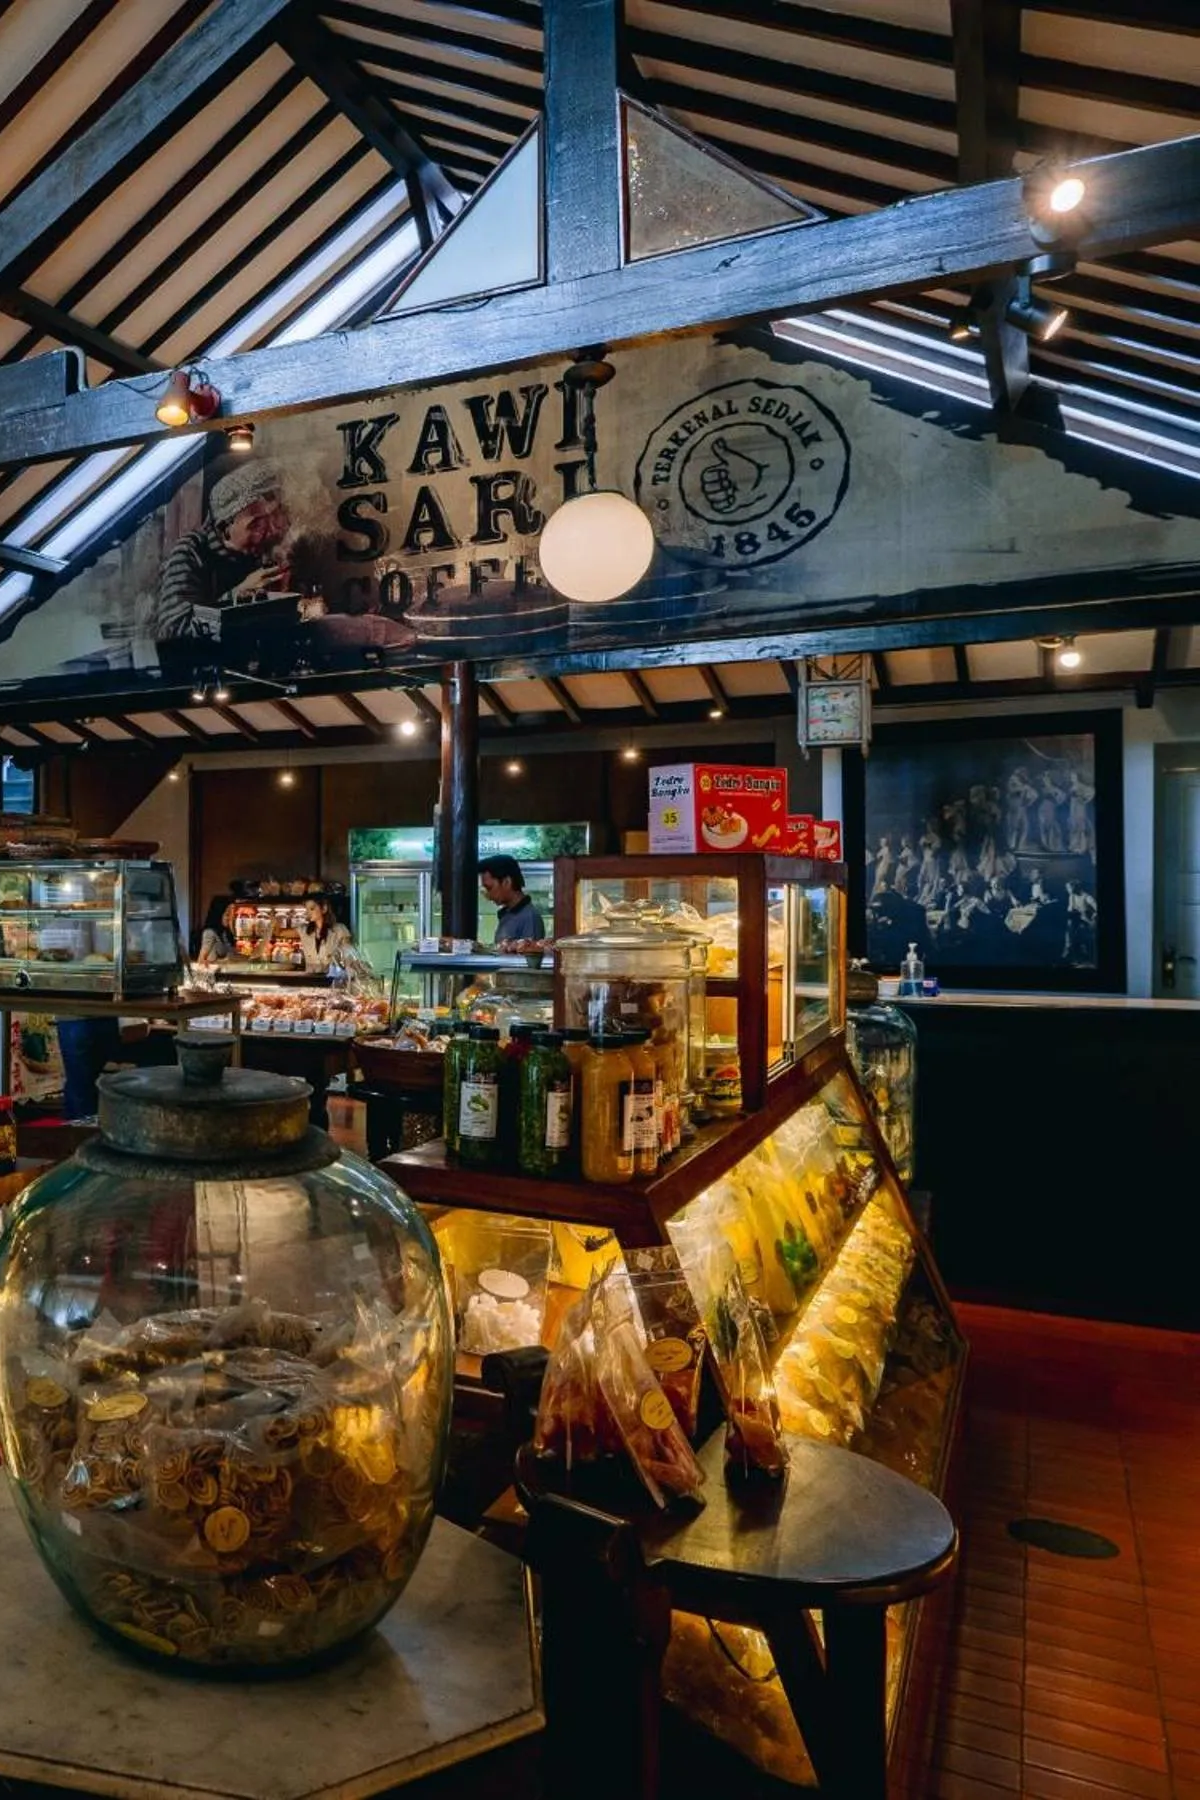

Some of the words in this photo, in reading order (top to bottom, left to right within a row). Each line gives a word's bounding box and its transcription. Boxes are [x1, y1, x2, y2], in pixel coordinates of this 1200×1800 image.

[336, 383, 596, 489] KAWI
[652, 400, 739, 486] TERKENAL
[747, 396, 823, 449] SEDJAK
[711, 502, 817, 558] 1845
[337, 555, 552, 616] COFFE
